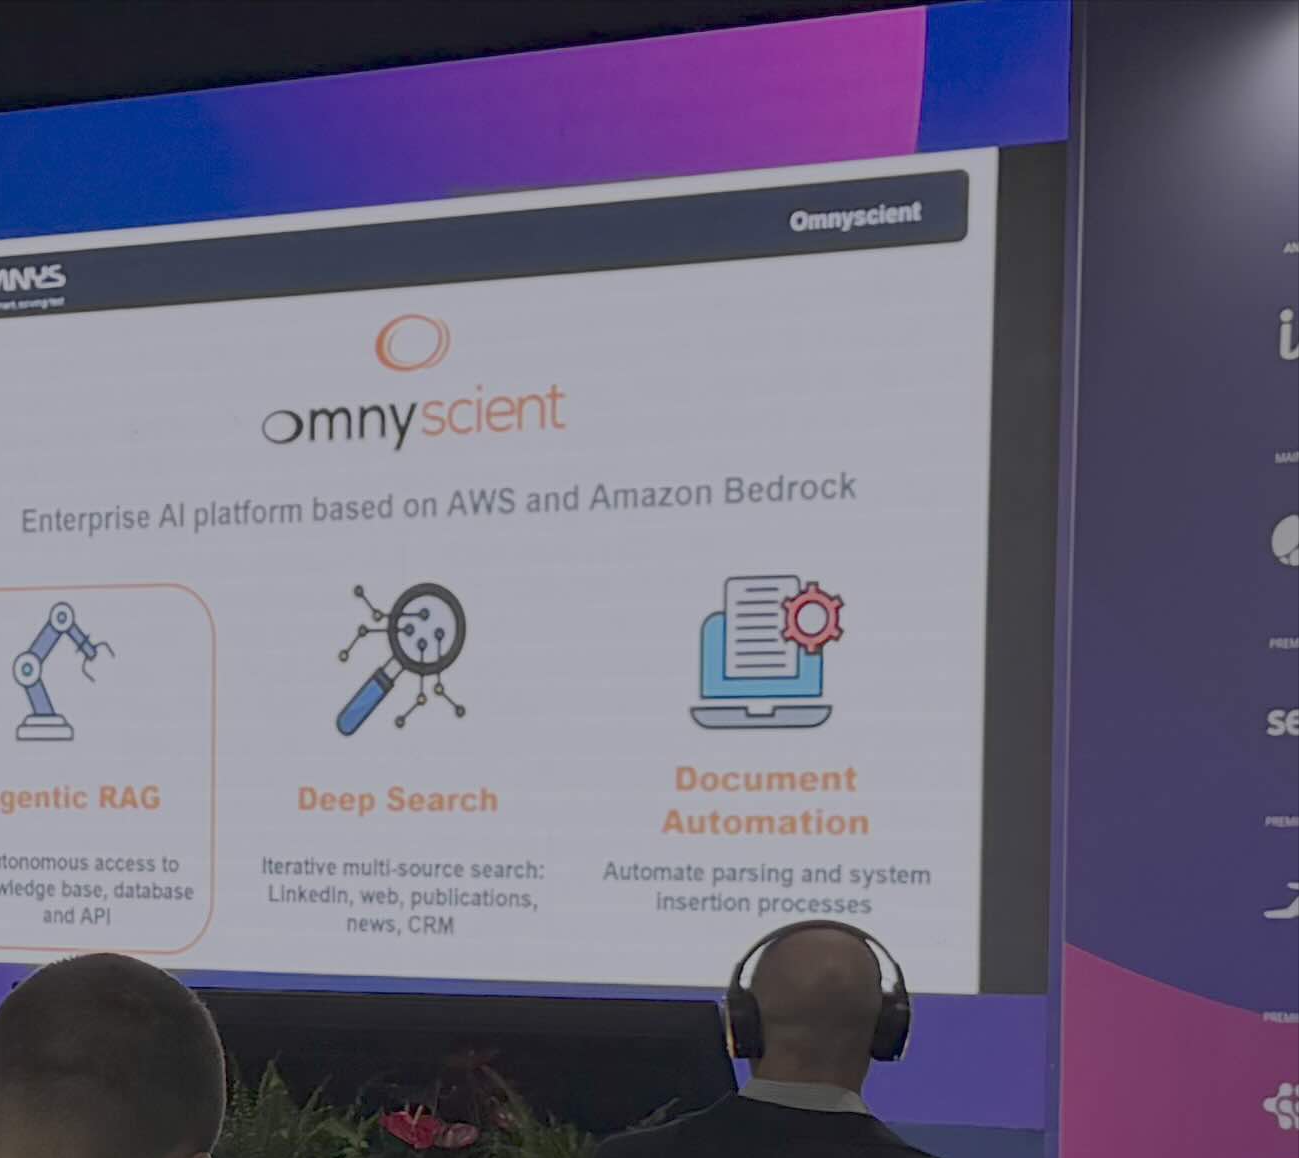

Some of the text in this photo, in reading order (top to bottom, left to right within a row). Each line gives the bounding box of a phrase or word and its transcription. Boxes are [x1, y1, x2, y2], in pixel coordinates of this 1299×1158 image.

[790, 202, 922, 232] Omnyscient
[22, 472, 856, 537] Enterprise AI platform based on AWS and Amazon Bedrock
[676, 766, 857, 792] Document
[99, 785, 161, 811] RAG
[298, 786, 498, 816] Deep Search
[662, 809, 869, 835] Automation
[95, 857, 156, 872] access
[162, 856, 180, 872] to
[262, 856, 544, 880] Iterative multi-source search:
[603, 861, 930, 890] Automate parsing and system
[61, 880, 107, 901] base,
[114, 881, 194, 900] database
[269, 884, 538, 911] LinkedIn, web, publications,
[43, 906, 110, 925] and API
[657, 892, 872, 917] insertion processes
[347, 915, 454, 936] news, CRM
